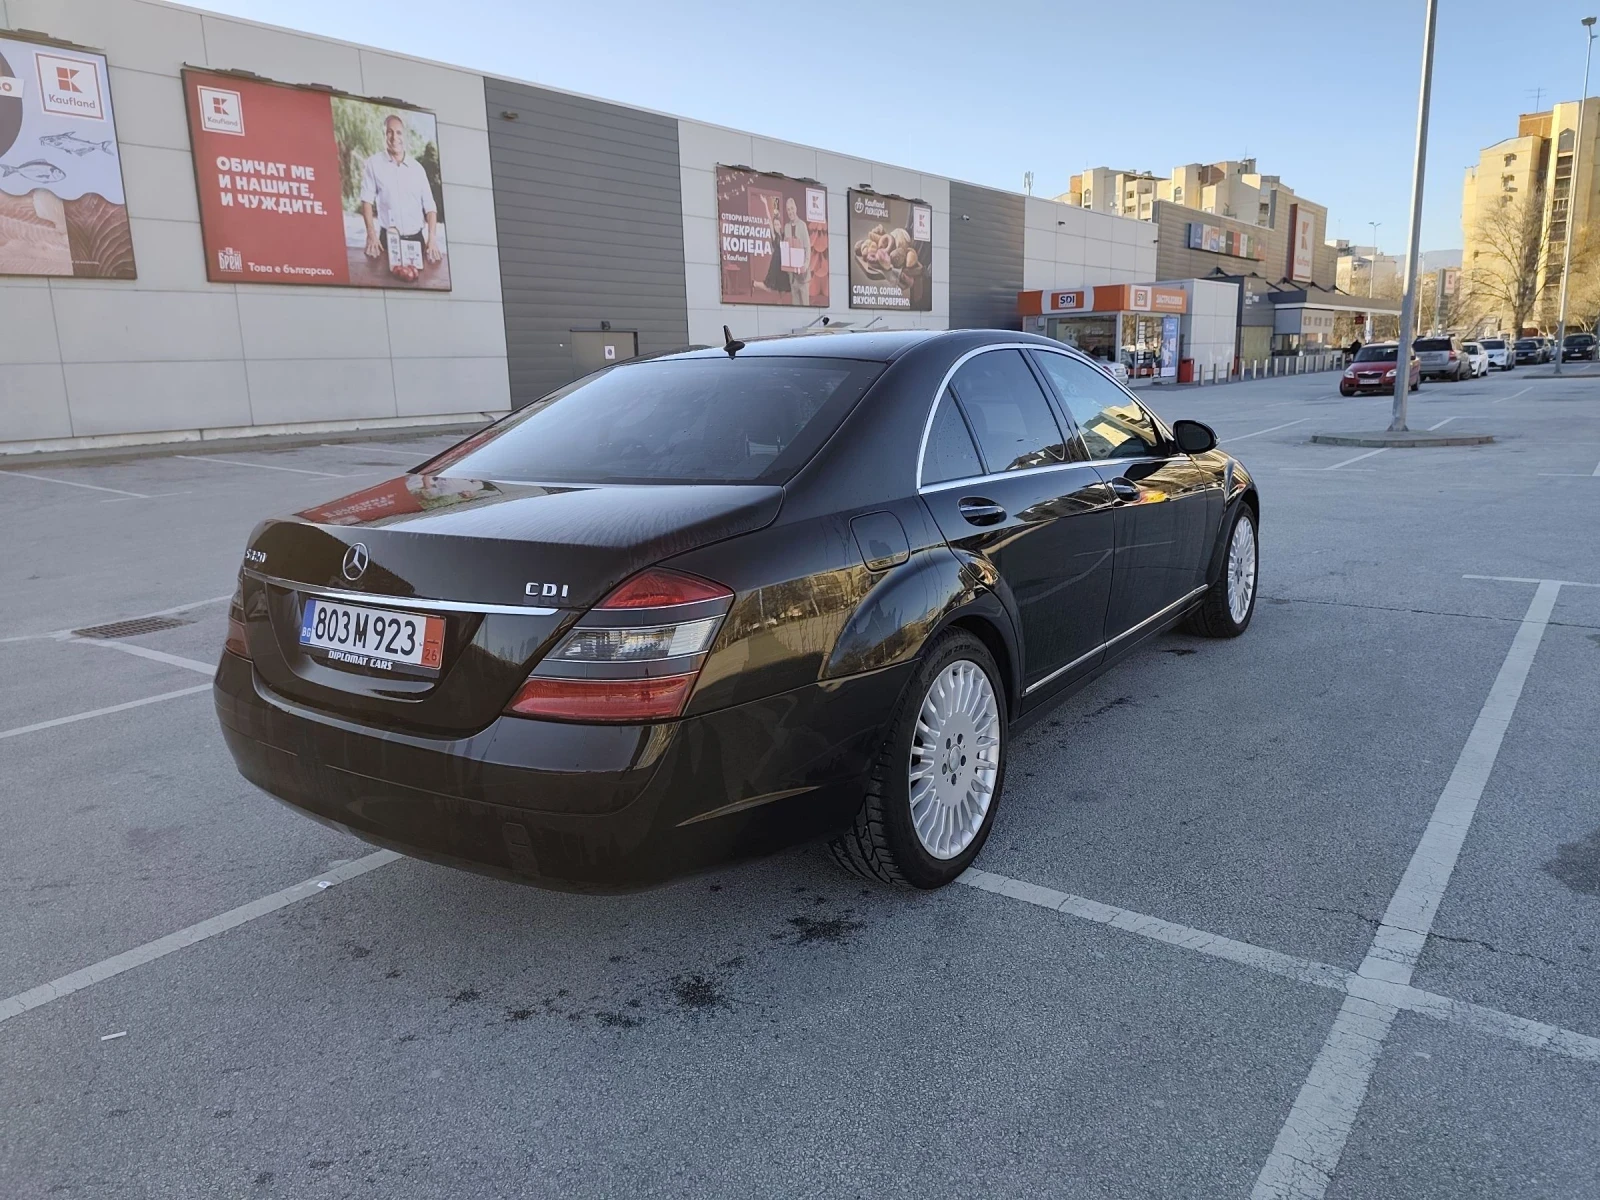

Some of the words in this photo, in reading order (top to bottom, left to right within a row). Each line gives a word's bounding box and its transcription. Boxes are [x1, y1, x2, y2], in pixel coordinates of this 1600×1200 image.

[48, 93, 96, 109] Kaufland
[207, 116, 238, 127] Kaufland
[216, 156, 286, 177] ОБИЧАТ
[290, 165, 315, 181] МЕ
[218, 174, 231, 189] И
[235, 176, 314, 199] НАШИТЕ,
[220, 191, 233, 207] И
[237, 193, 327, 215] ЧУЖДИТЕ.
[721, 213, 743, 222] ОТВОРИ
[743, 215, 763, 224] ВРАТАТА
[722, 223, 771, 239] ПРЕКРАСНА
[722, 236, 772, 257] КОЛЕДА
[726, 253, 748, 262] Kaufland
[248, 262, 273, 273] Това
[274, 265, 281, 273] е
[853, 285, 878, 296] СЛАДКО.
[879, 286, 903, 296] СОЛЕНО.
[853, 295, 877, 305] ВКУСНО.
[877, 296, 911, 307] ПРОВЕРЕНО.
[1060, 295, 1075, 304] SDI
[525, 582, 569, 598] CDI
[301, 627, 312, 638] BG
[315, 606, 351, 645] 803
[352, 612, 370, 649] M
[373, 616, 417, 656] 923
[328, 650, 369, 666] DIPLOMAT
[369, 658, 394, 671] CARS
[424, 648, 437, 661] 26
